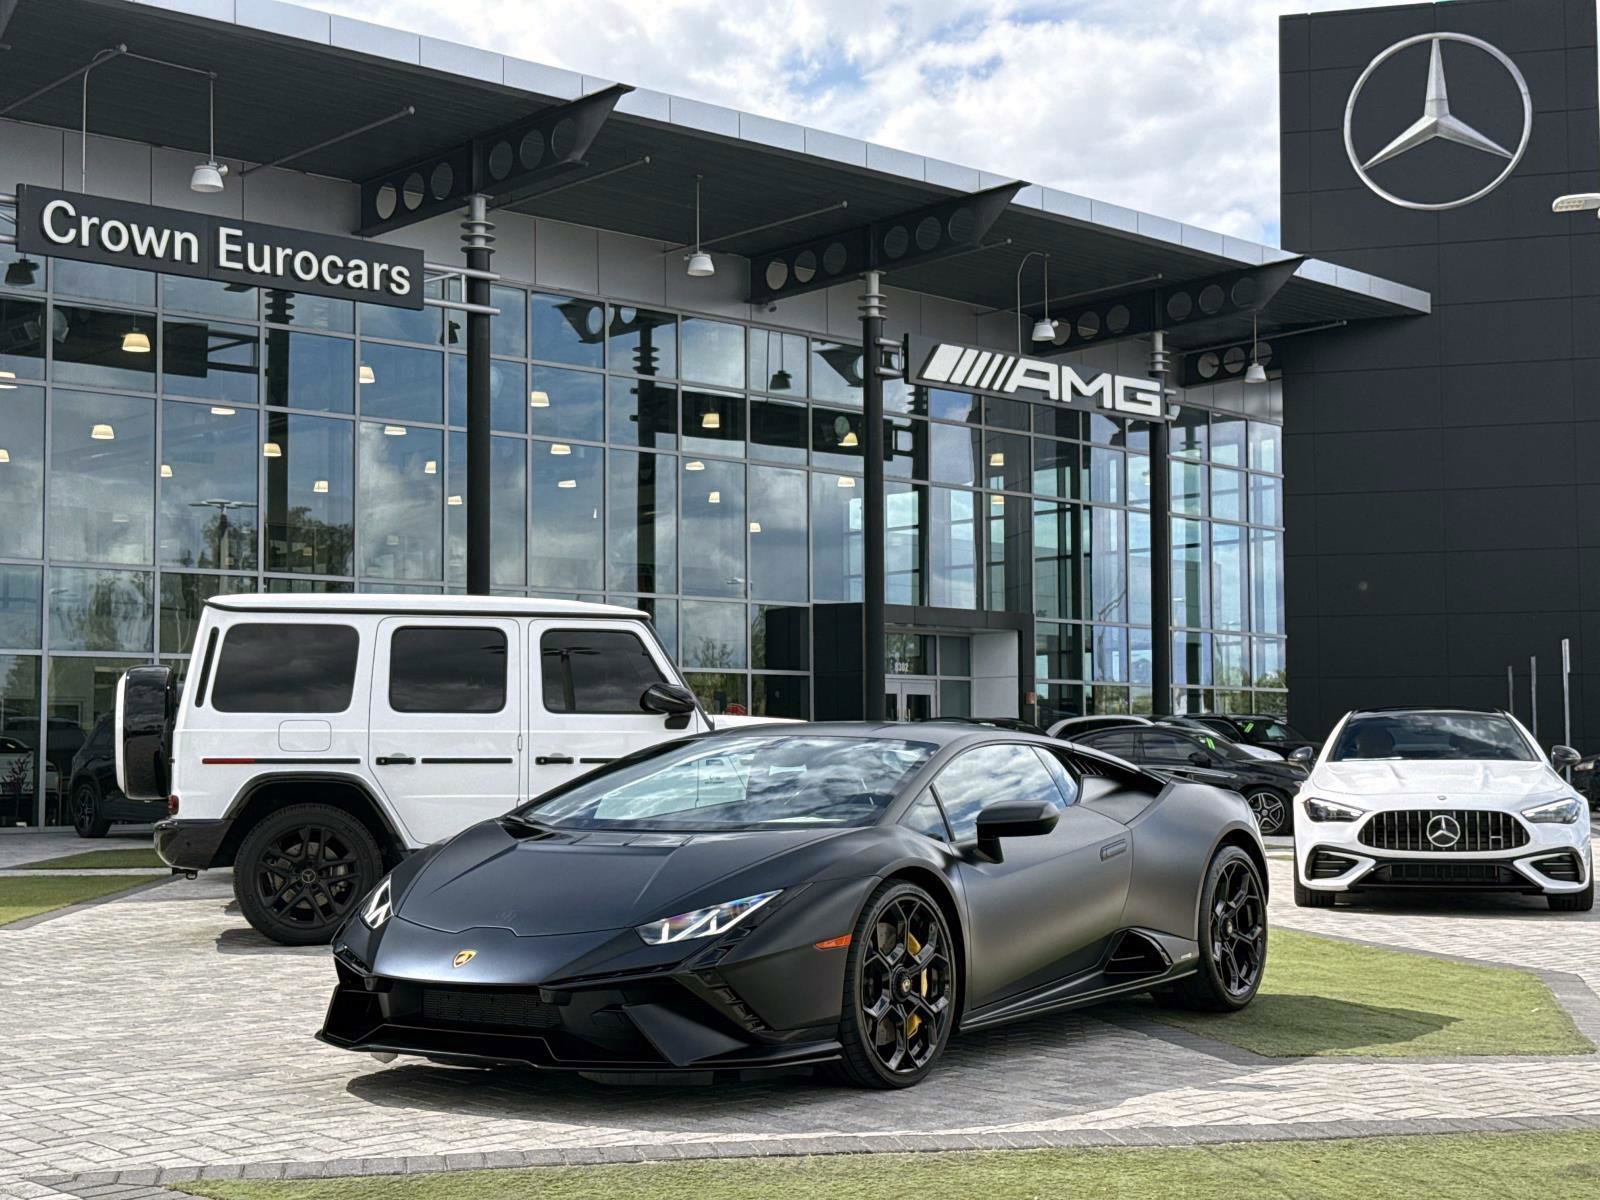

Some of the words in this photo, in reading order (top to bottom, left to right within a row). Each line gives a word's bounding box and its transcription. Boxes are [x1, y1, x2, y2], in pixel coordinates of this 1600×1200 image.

[42, 200, 199, 263] Crown
[219, 227, 411, 295] Eurocars
[1003, 357, 1161, 417] AMG
